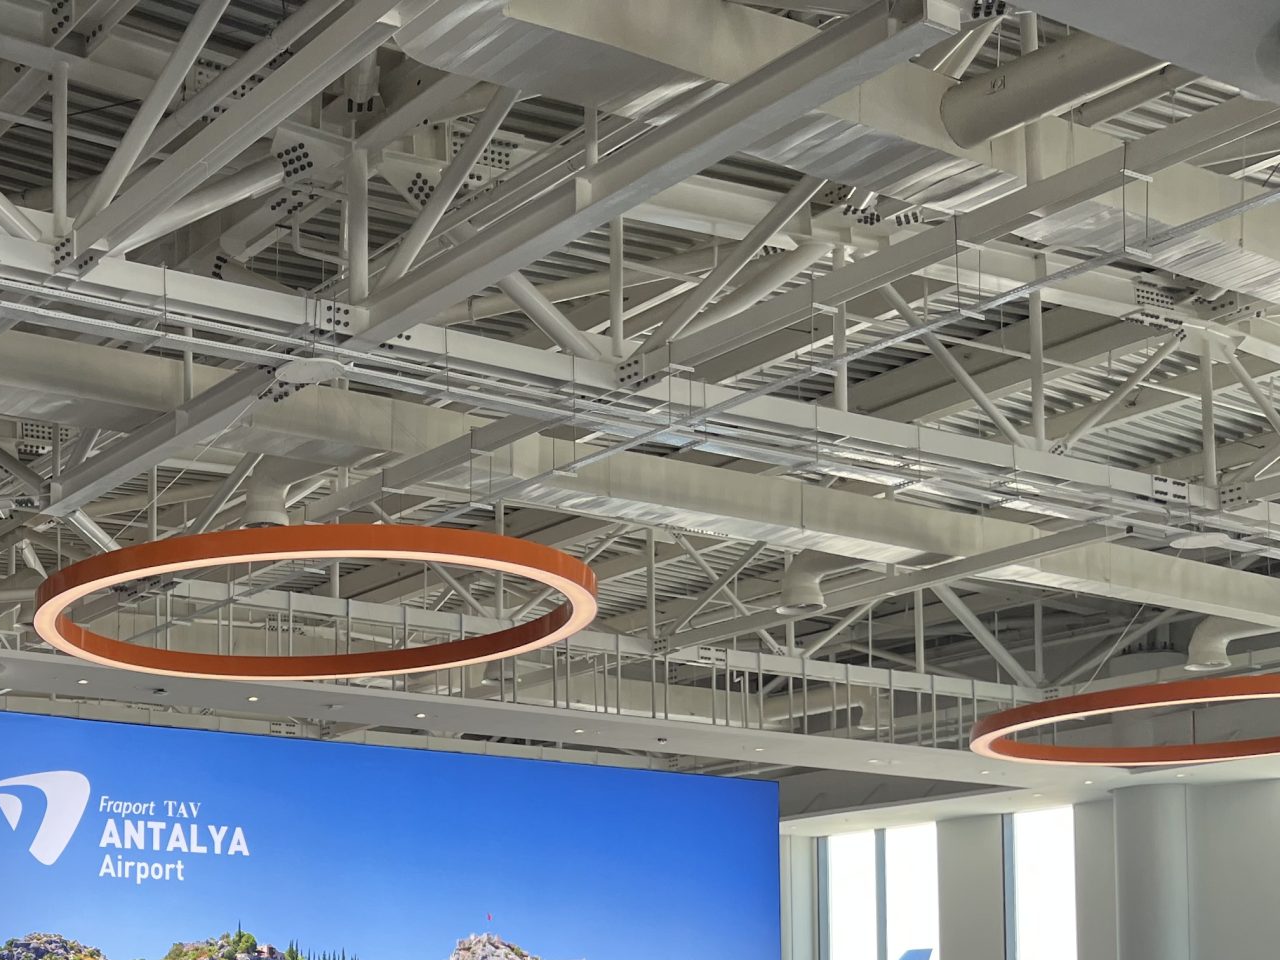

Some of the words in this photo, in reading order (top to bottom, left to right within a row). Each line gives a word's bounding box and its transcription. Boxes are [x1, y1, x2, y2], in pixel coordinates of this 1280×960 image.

[99, 796, 156, 818] Fraport
[163, 800, 202, 819] TAV
[99, 818, 250, 856] ANTALYA
[99, 854, 185, 885] Airport
